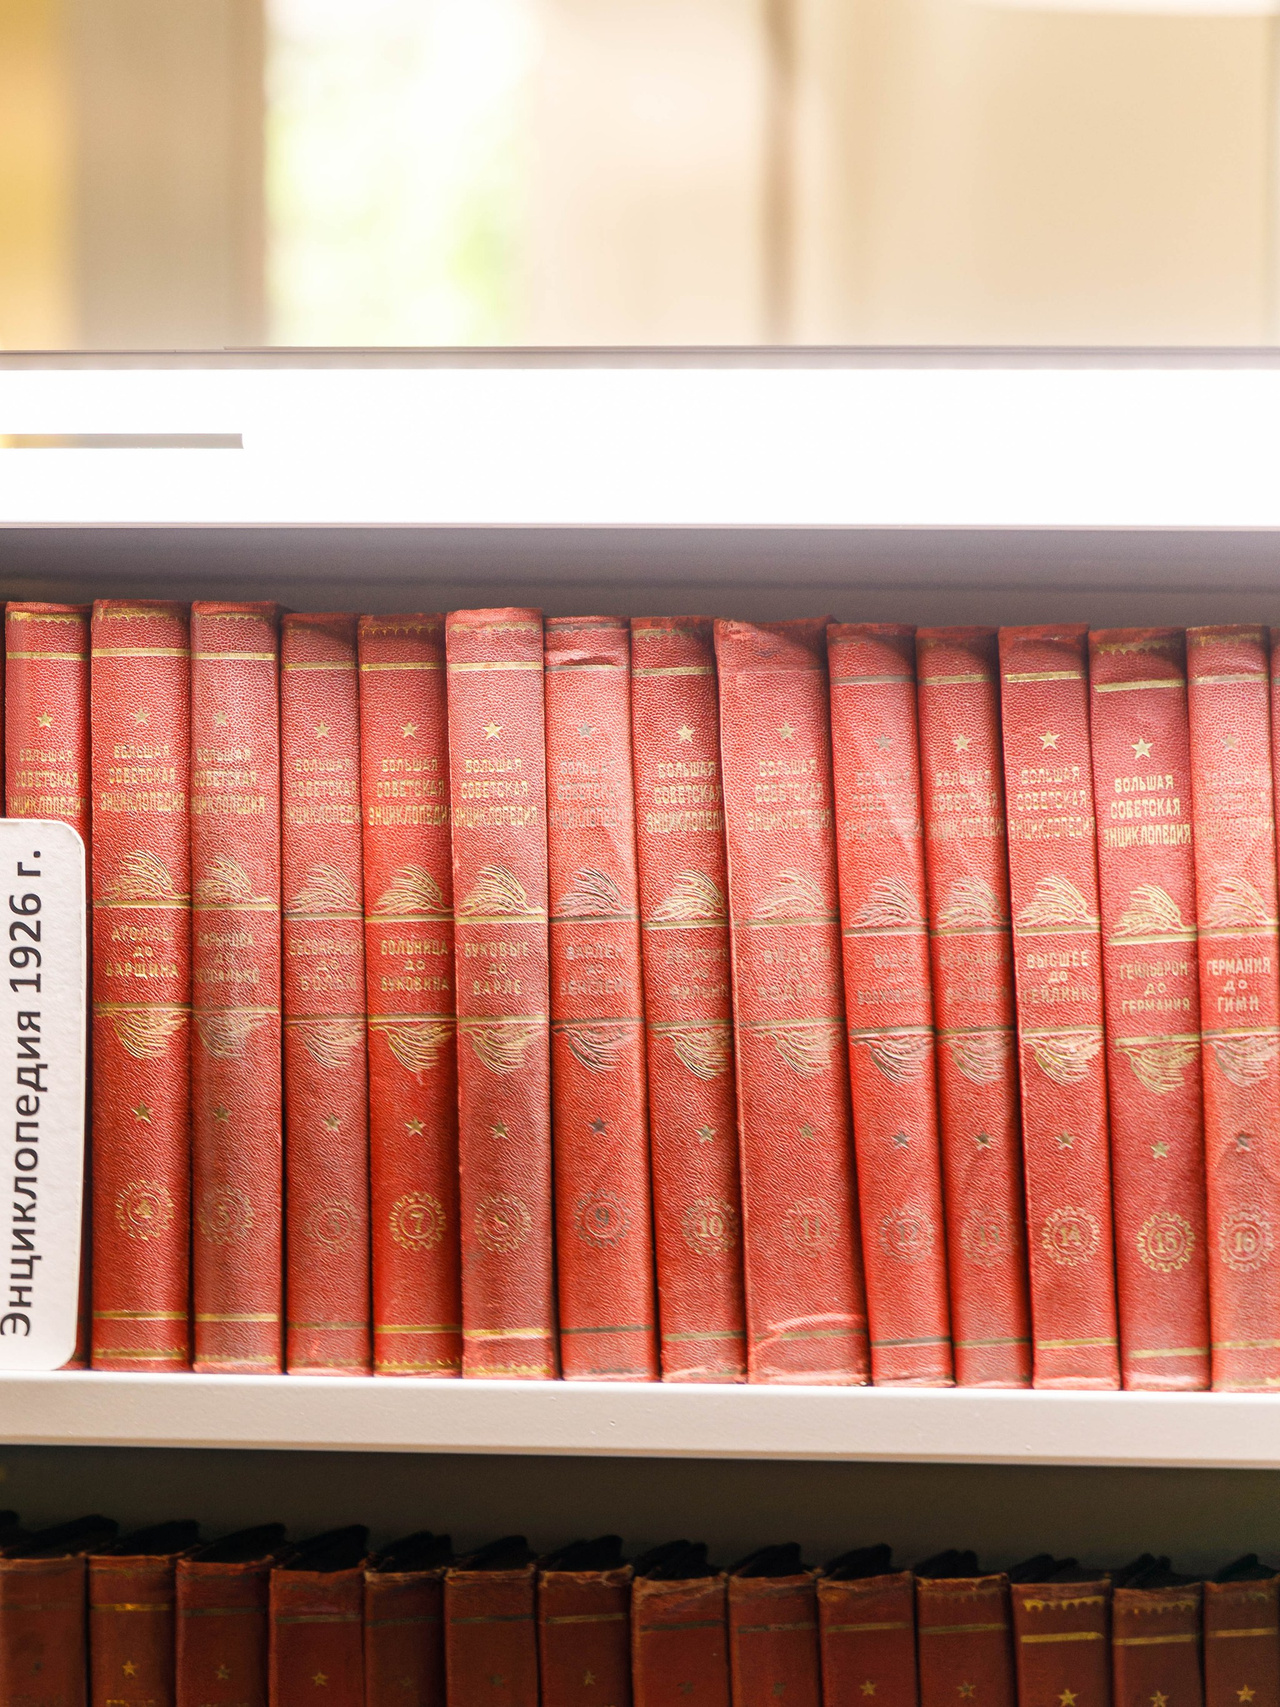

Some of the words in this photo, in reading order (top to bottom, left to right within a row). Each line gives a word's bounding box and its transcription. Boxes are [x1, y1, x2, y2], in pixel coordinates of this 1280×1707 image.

[382, 758, 438, 772] БОЛЬШАЯ
[465, 758, 522, 773] БОЛЬШАЯ
[109, 767, 176, 783] СОВЕТСКАЯ
[1021, 766, 1080, 784] БОЛЬШАЯ
[1114, 774, 1174, 793] БОЛЬШАЯ
[376, 780, 446, 798] СОВЕТСКАЯ
[461, 780, 528, 798] СОВЕТСКАЯ
[1017, 790, 1087, 810] СОВЕТСКАЯ
[1110, 798, 1181, 819] СОВЕТСКАЯ
[1104, 824, 1192, 848] ЭНЦИКЛОПЕДИЯ
[17, 851, 40, 876] г.
[9, 894, 41, 992] 1926
[381, 939, 449, 955] БОЛЬНИЦА
[464, 941, 529, 958] БУКОВЫЕ
[1026, 950, 1089, 969] ВЫСШЕЕ
[1206, 957, 1271, 977] ГЕРМАНИЯ
[1121, 998, 1191, 1016] ГЕРМАНИЯ
[1217, 996, 1260, 1013] ГИМН
[0, 1012, 48, 1336] Энциклопедия
[699, 1216, 721, 1237] 10
[1155, 1233, 1176, 1253] 15
[1234, 1232, 1256, 1252] 16
